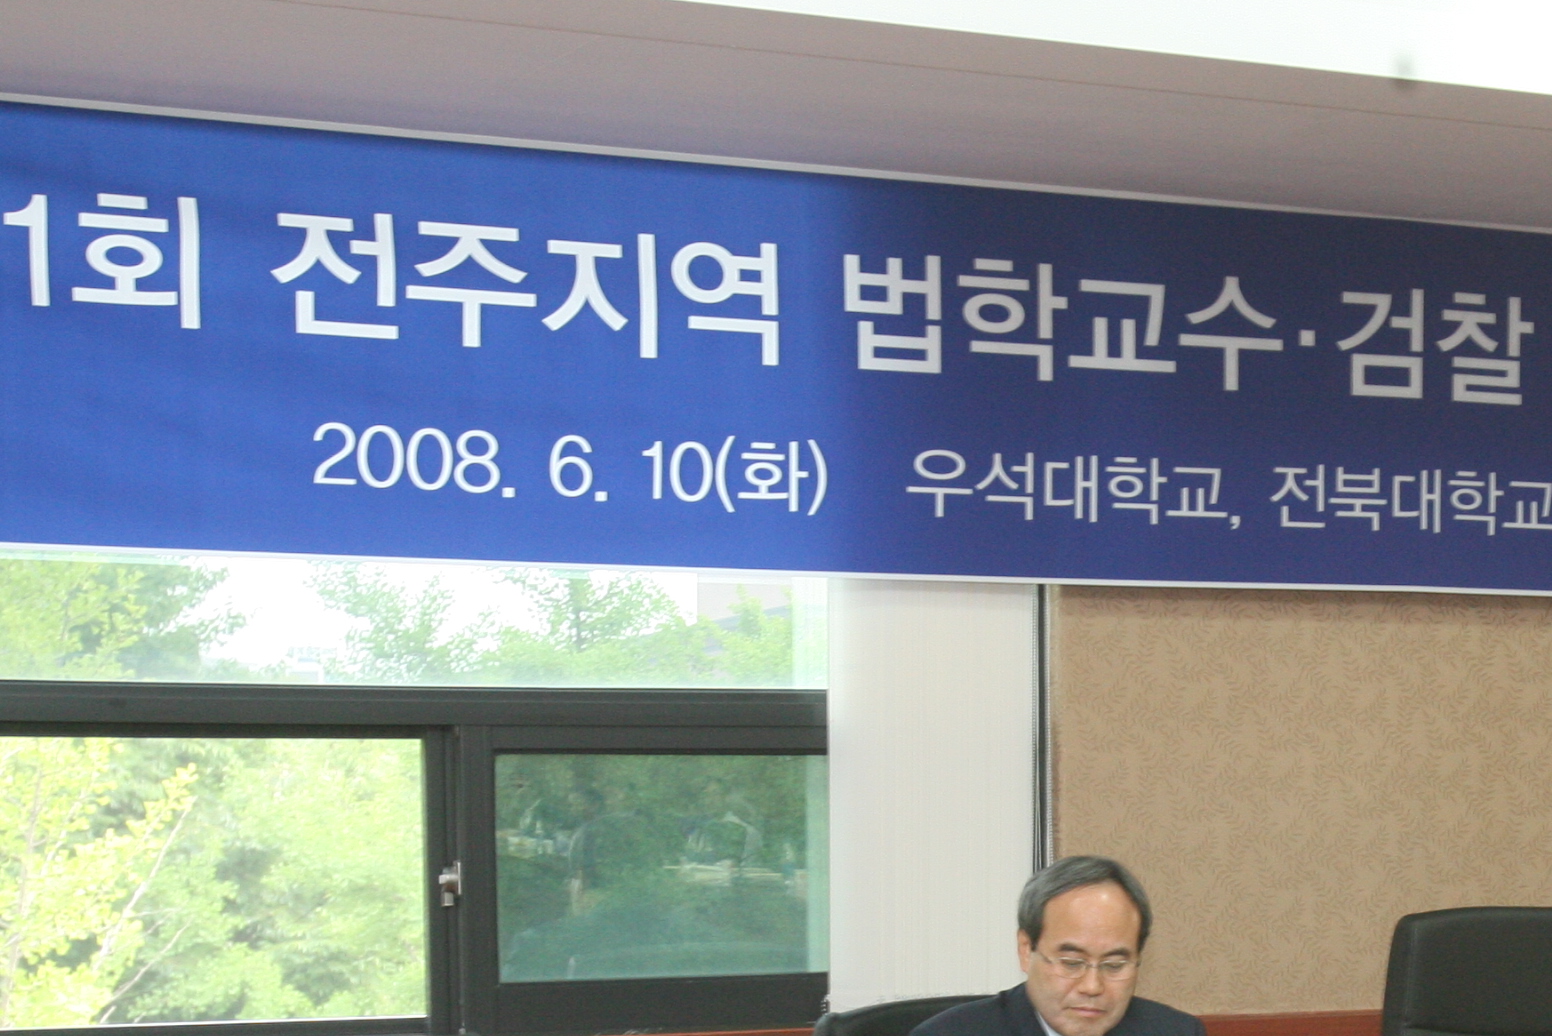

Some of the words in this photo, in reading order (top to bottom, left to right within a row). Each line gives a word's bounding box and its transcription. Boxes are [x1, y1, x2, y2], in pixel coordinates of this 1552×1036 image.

[3, 192, 201, 330] 1회
[270, 212, 780, 367] 전주지역
[312, 421, 516, 499] 2008.
[548, 434, 609, 503] 6.
[641, 434, 828, 517] 10(화)
[905, 449, 1241, 530] 우석대학교,
